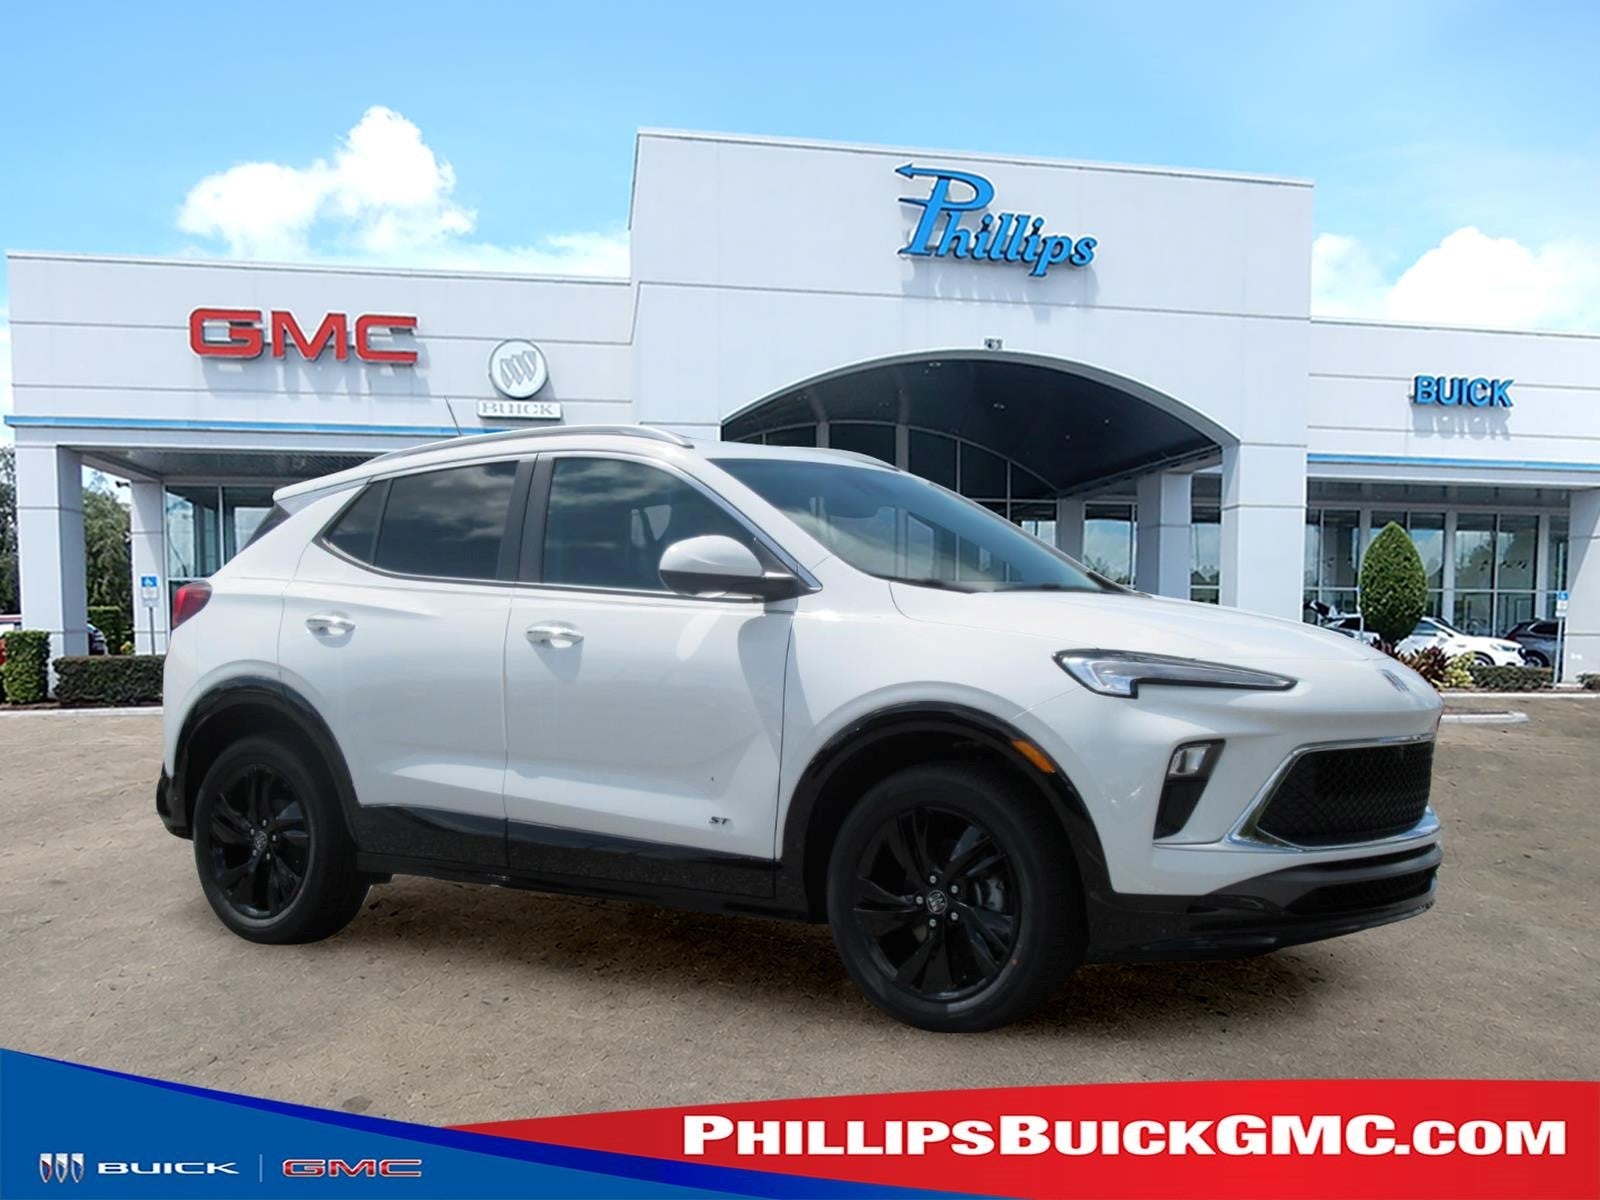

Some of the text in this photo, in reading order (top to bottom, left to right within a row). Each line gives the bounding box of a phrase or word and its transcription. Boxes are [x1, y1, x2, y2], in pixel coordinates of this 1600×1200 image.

[895, 163, 1098, 277] Phillips
[189, 307, 418, 365] GMC
[1414, 375, 1514, 408] BUICK
[482, 402, 555, 415] BUICK
[709, 816, 731, 825] ST
